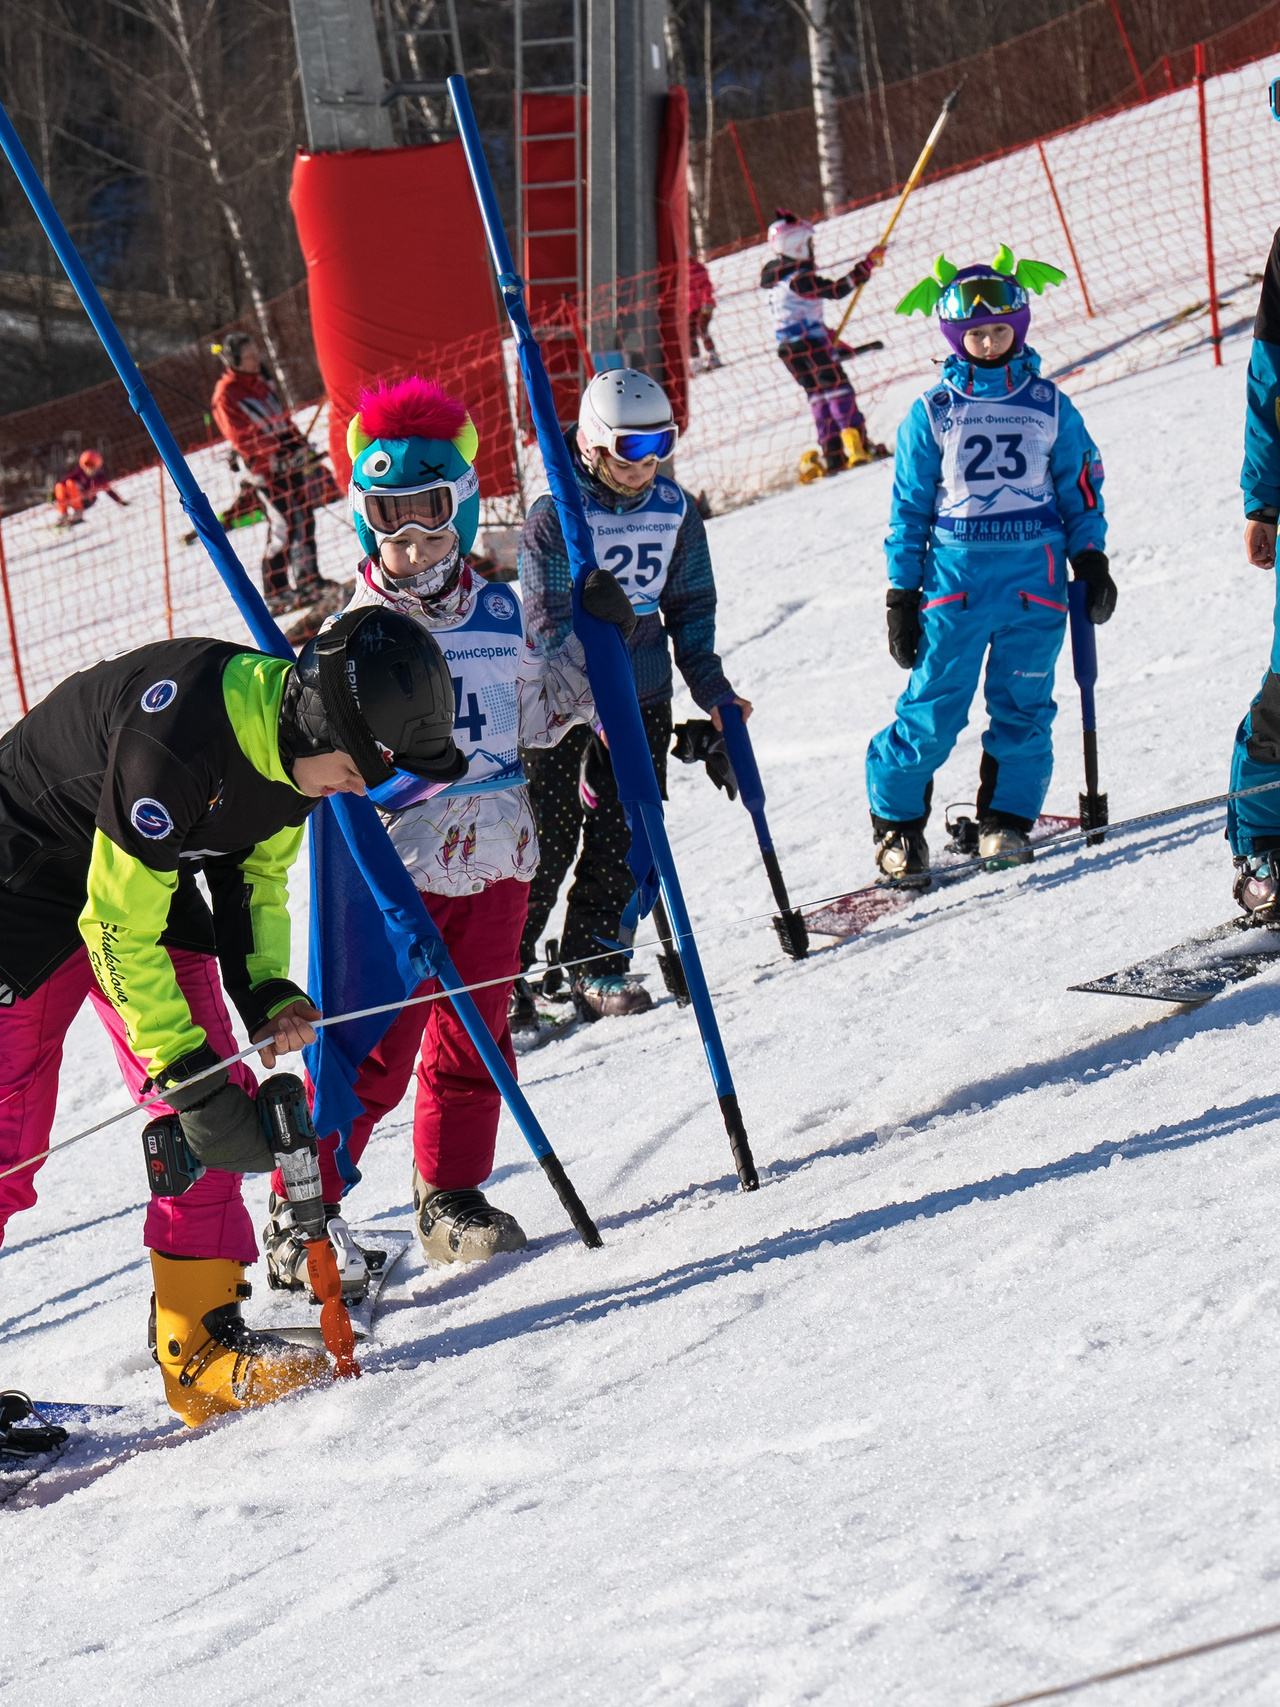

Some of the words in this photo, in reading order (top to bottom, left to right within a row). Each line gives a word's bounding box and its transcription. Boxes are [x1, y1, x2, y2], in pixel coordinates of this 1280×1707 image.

[956, 416, 983, 426] Банк
[964, 433, 1027, 482] 23
[598, 525, 625, 536] Банк
[954, 519, 1042, 533] ШУКОЛОВО
[604, 543, 663, 588] 25
[444, 646, 518, 661] Финсервис
[100, 921, 128, 1004] Shukolovo
[148, 1136, 157, 1152] 18V
